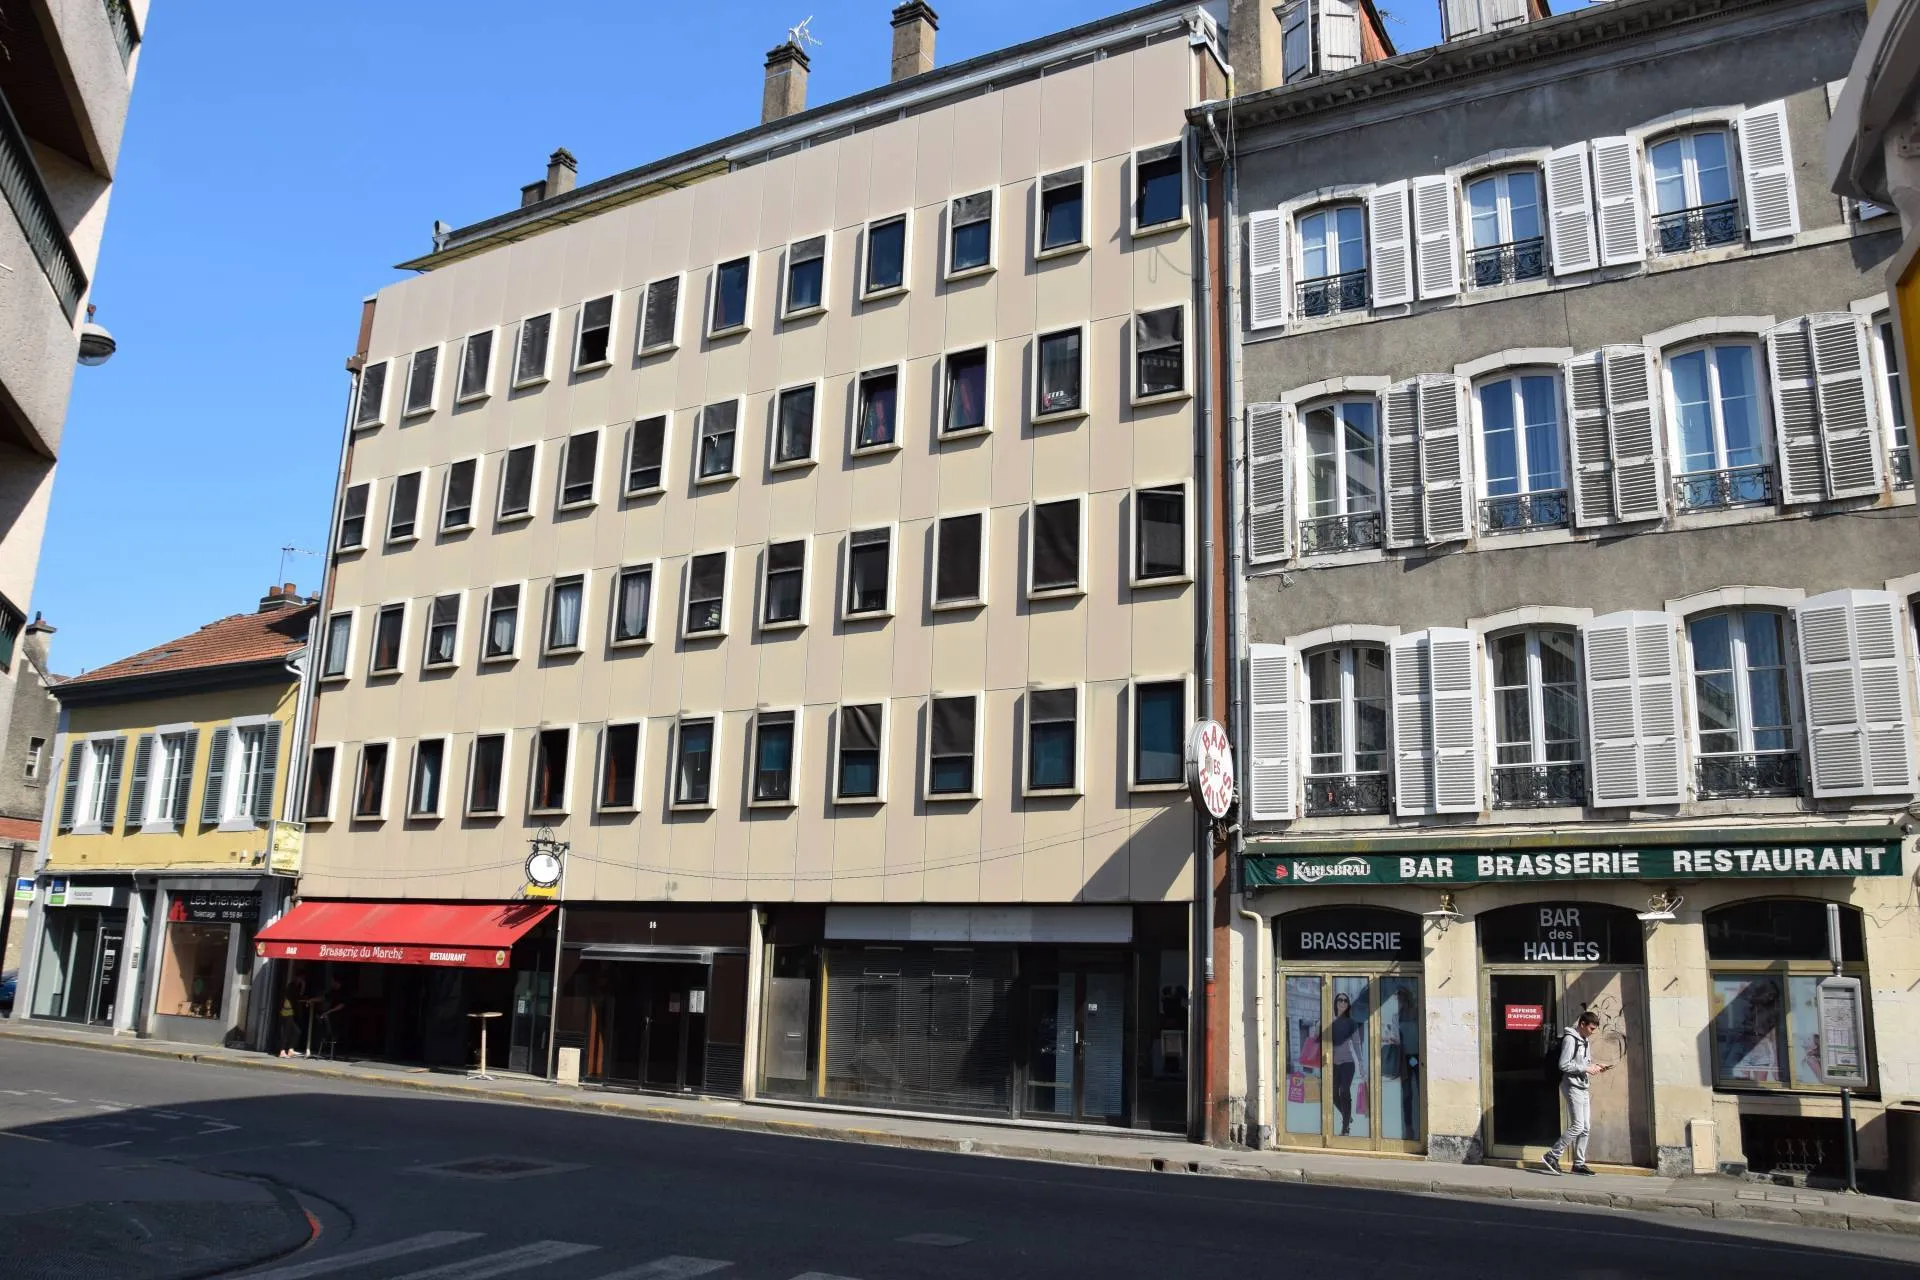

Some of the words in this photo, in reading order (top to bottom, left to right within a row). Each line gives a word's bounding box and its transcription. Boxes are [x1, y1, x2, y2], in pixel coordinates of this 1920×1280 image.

[1202, 726, 1226, 757] BAR
[1200, 767, 1232, 813] HALLES
[1399, 857, 1453, 878] BAR
[1477, 853, 1640, 876] BRASSERIE
[1673, 848, 1886, 872] RESTAURANT
[1540, 907, 1580, 927] BAR
[1300, 931, 1401, 950] BRASSERIE
[1548, 928, 1573, 940] des
[285, 946, 298, 955] BAR
[319, 944, 359, 958] Brasserie
[360, 946, 371, 958] du
[373, 946, 404, 960] Marché
[429, 951, 467, 962] RESTAURANT
[1524, 941, 1600, 961] HALLES
